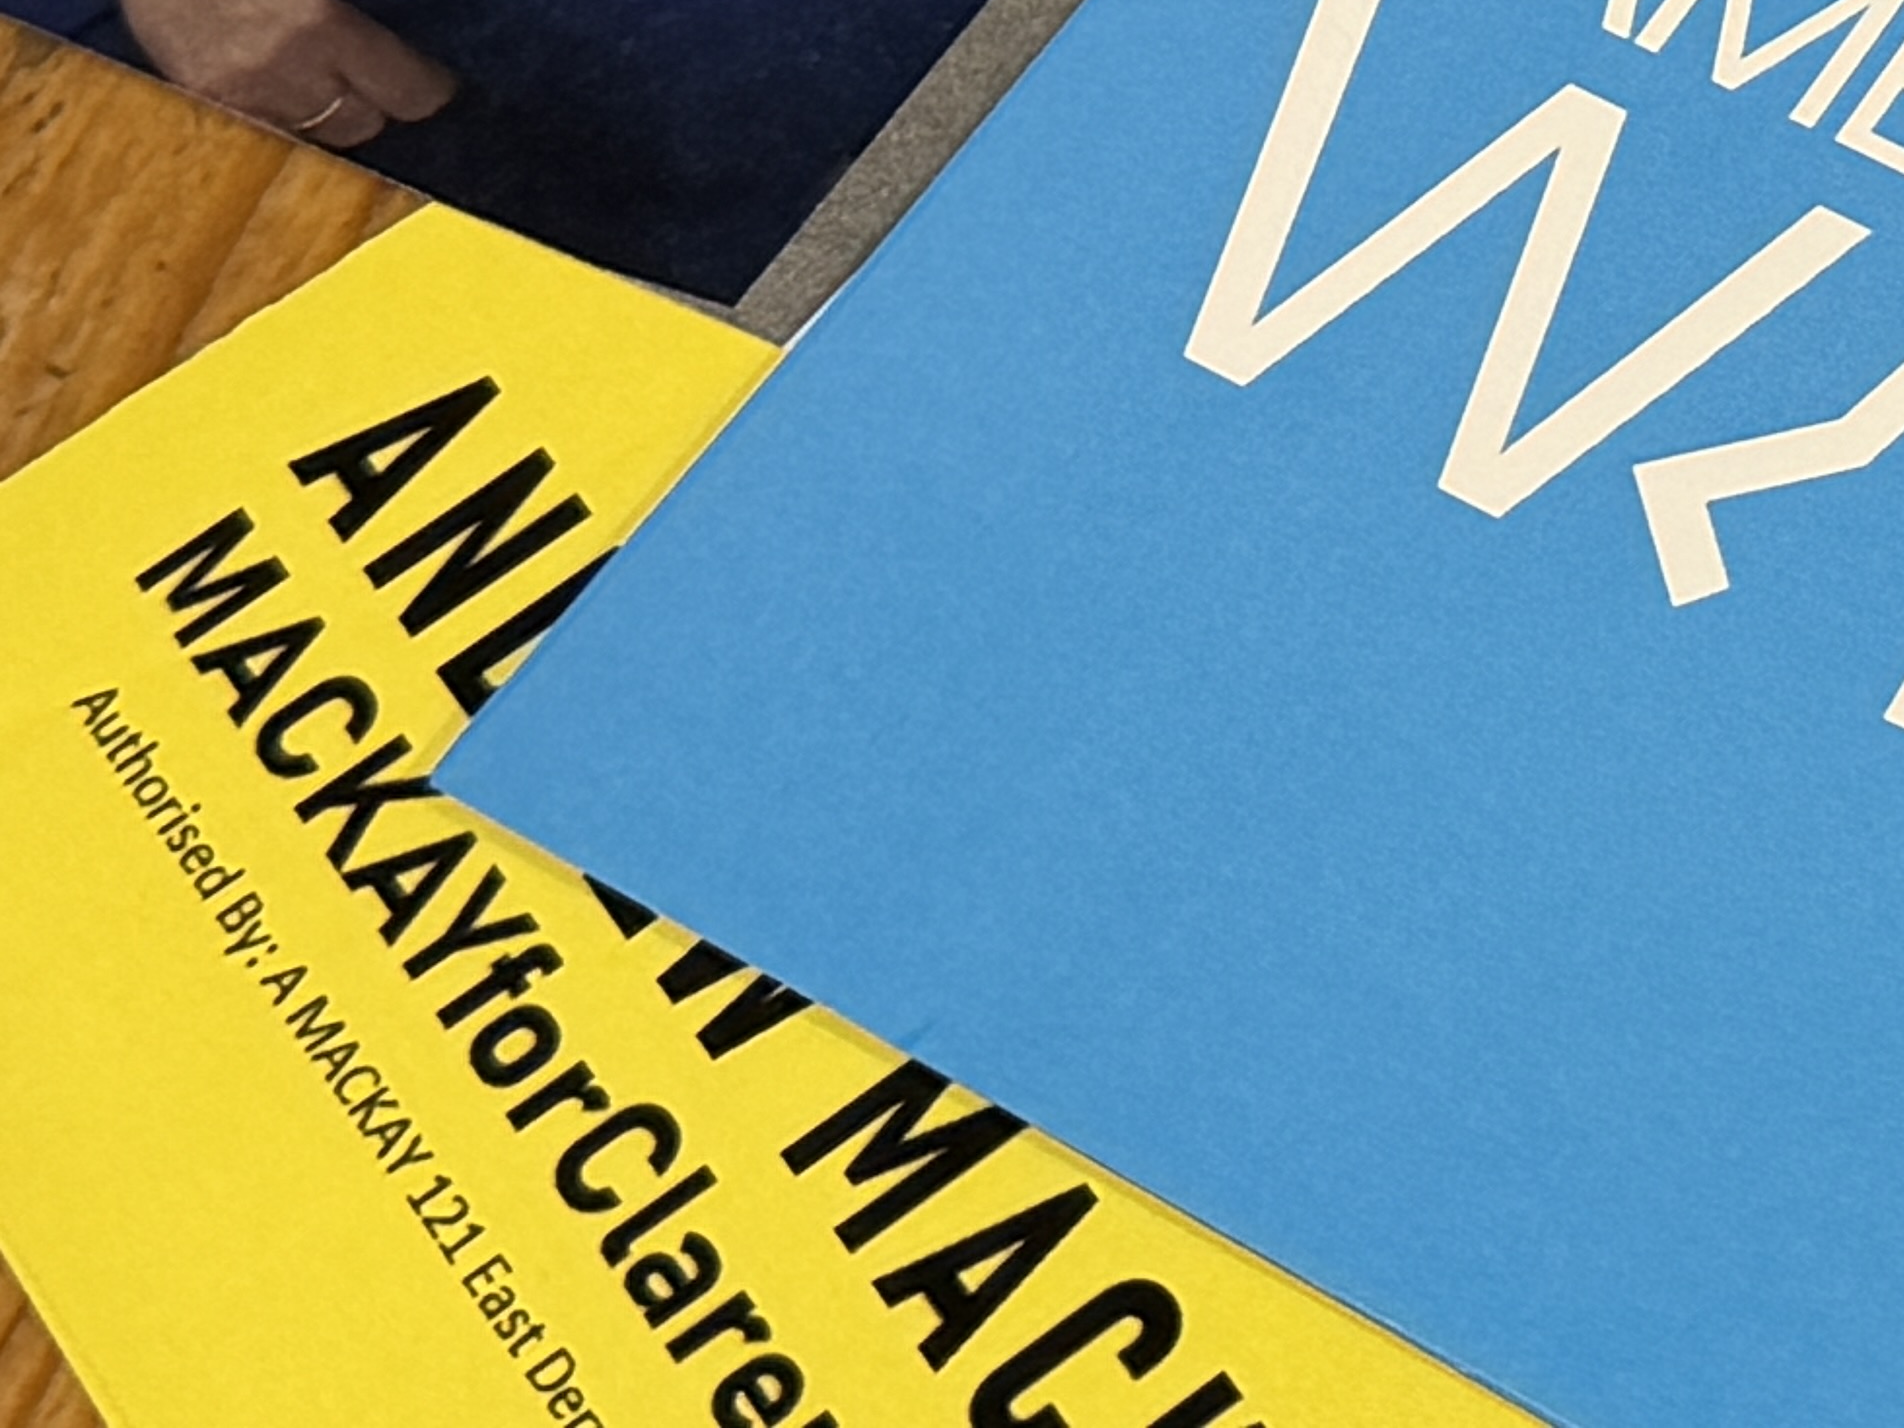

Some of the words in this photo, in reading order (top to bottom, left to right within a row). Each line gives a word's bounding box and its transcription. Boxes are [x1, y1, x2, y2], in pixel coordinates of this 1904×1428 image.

[69, 685, 245, 901] Authorised
[214, 889, 279, 970] By:
[259, 964, 310, 1007] A
[285, 994, 434, 1177] MACKAY
[405, 1173, 487, 1267] 121
[460, 1252, 546, 1361] East
[134, 505, 840, 1428] MACKAYforClare
